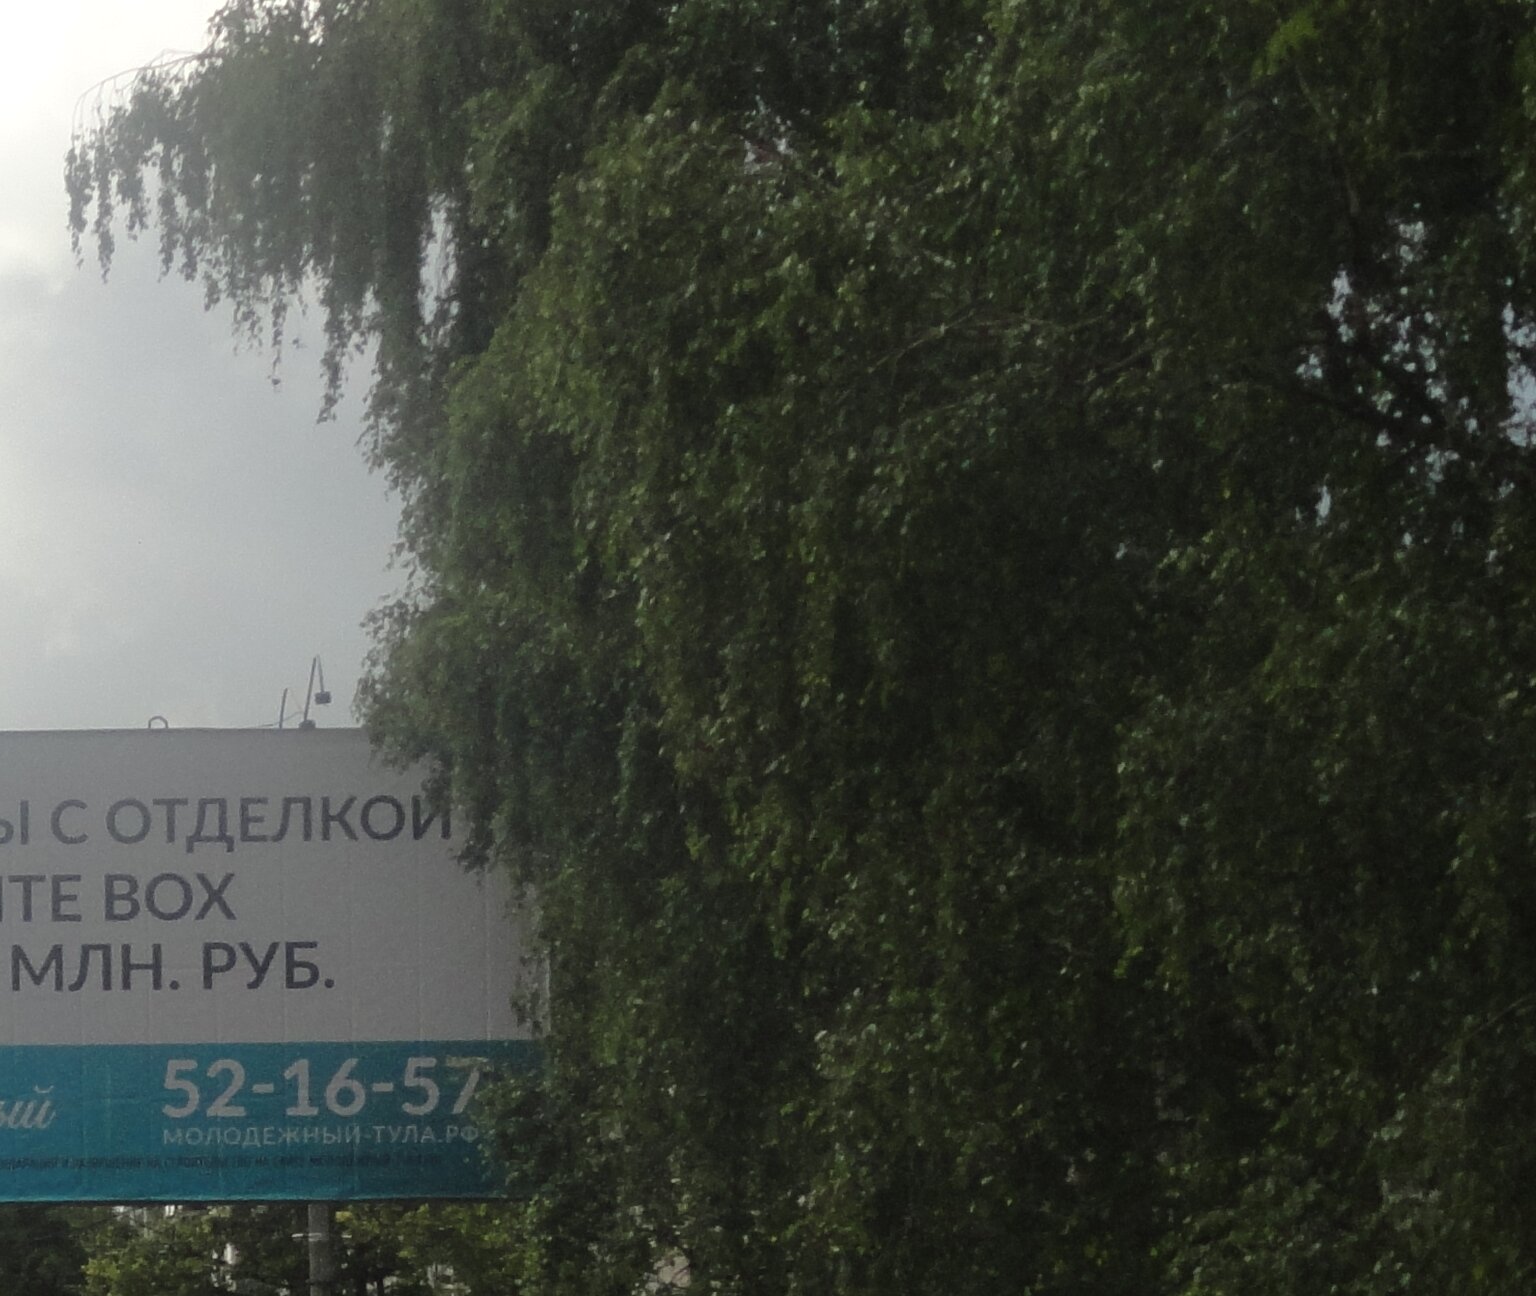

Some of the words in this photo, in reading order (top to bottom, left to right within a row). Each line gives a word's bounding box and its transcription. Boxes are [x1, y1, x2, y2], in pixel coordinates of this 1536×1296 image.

[49, 798, 90, 845] С
[103, 872, 238, 923] BOX
[10, 942, 181, 993] МЛН.
[201, 940, 336, 992] РУБ.
[161, 1056, 488, 1118] 52-16-57
[161, 1124, 479, 1149] МОЛОДЕЖНЫЙ-ТУЛА.РФ
